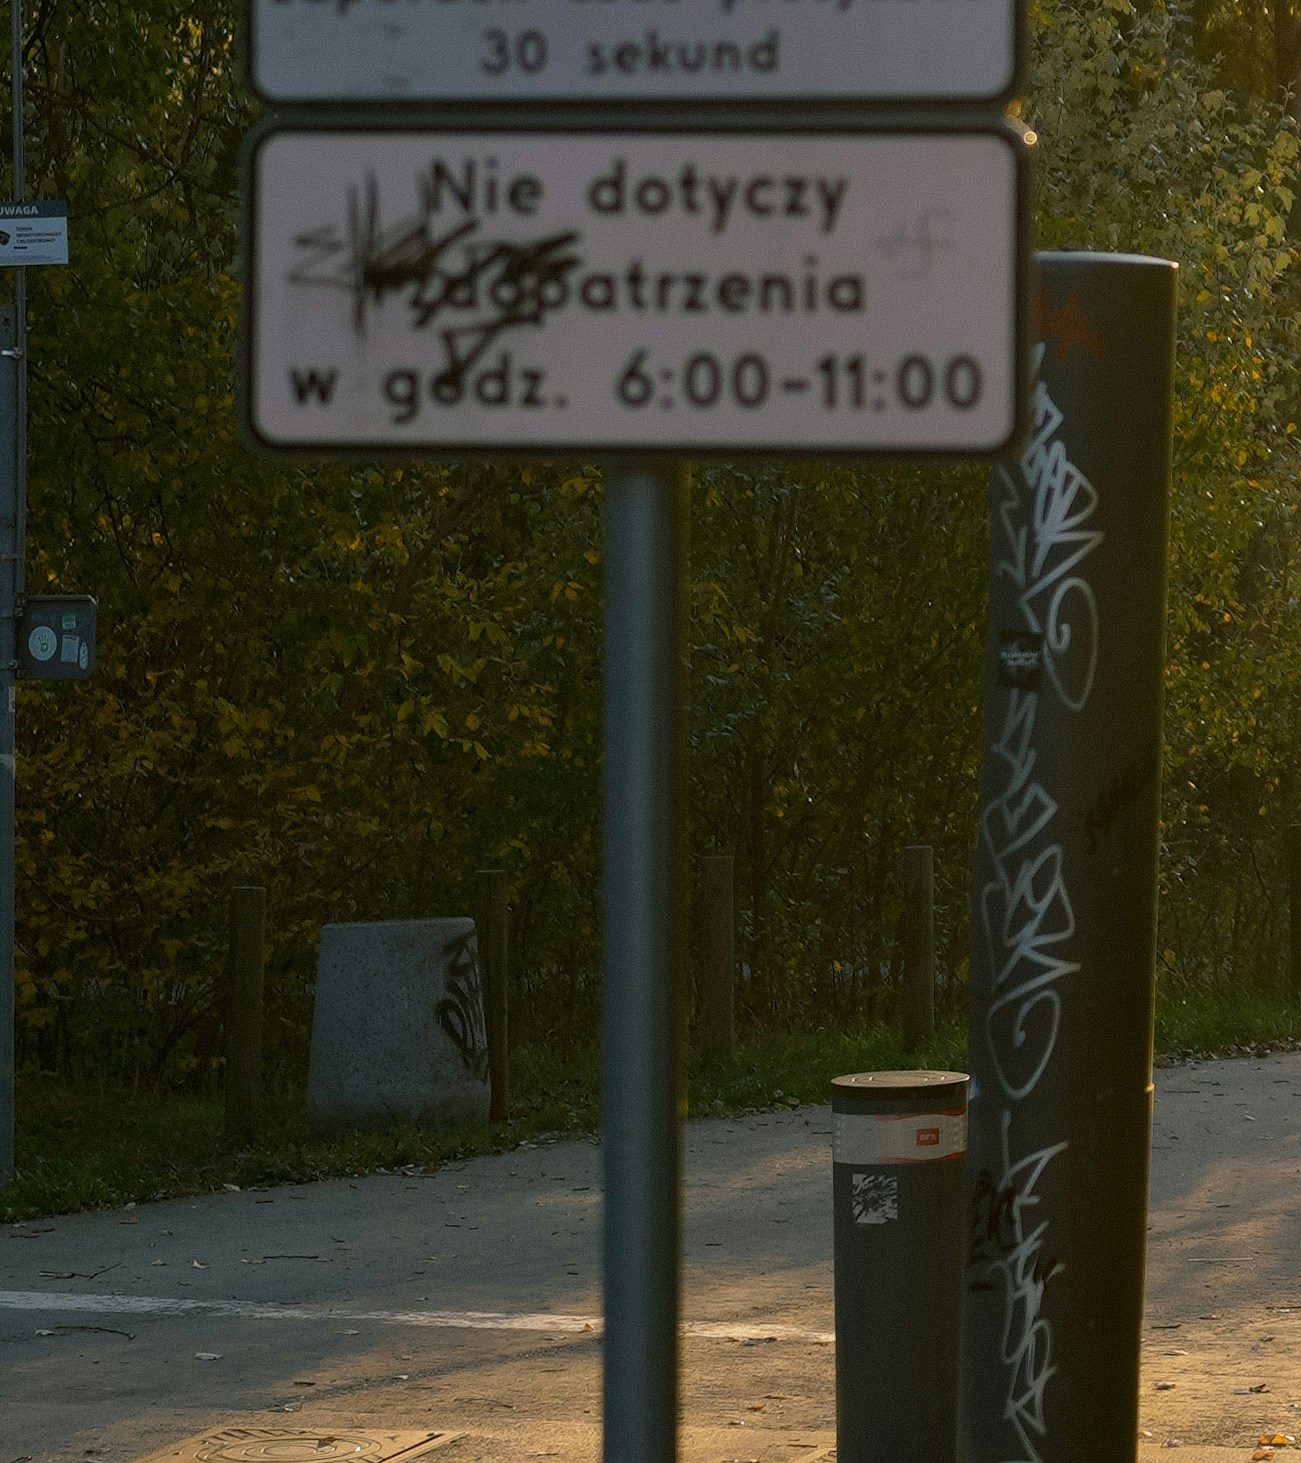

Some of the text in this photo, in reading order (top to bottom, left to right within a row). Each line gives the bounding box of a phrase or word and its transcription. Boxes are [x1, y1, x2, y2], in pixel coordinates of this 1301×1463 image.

[481, 29, 781, 77] 30 sekund
[428, 158, 850, 232] Nie dotyczy
[289, 346, 985, 423] w godz. 6:00-11:00
